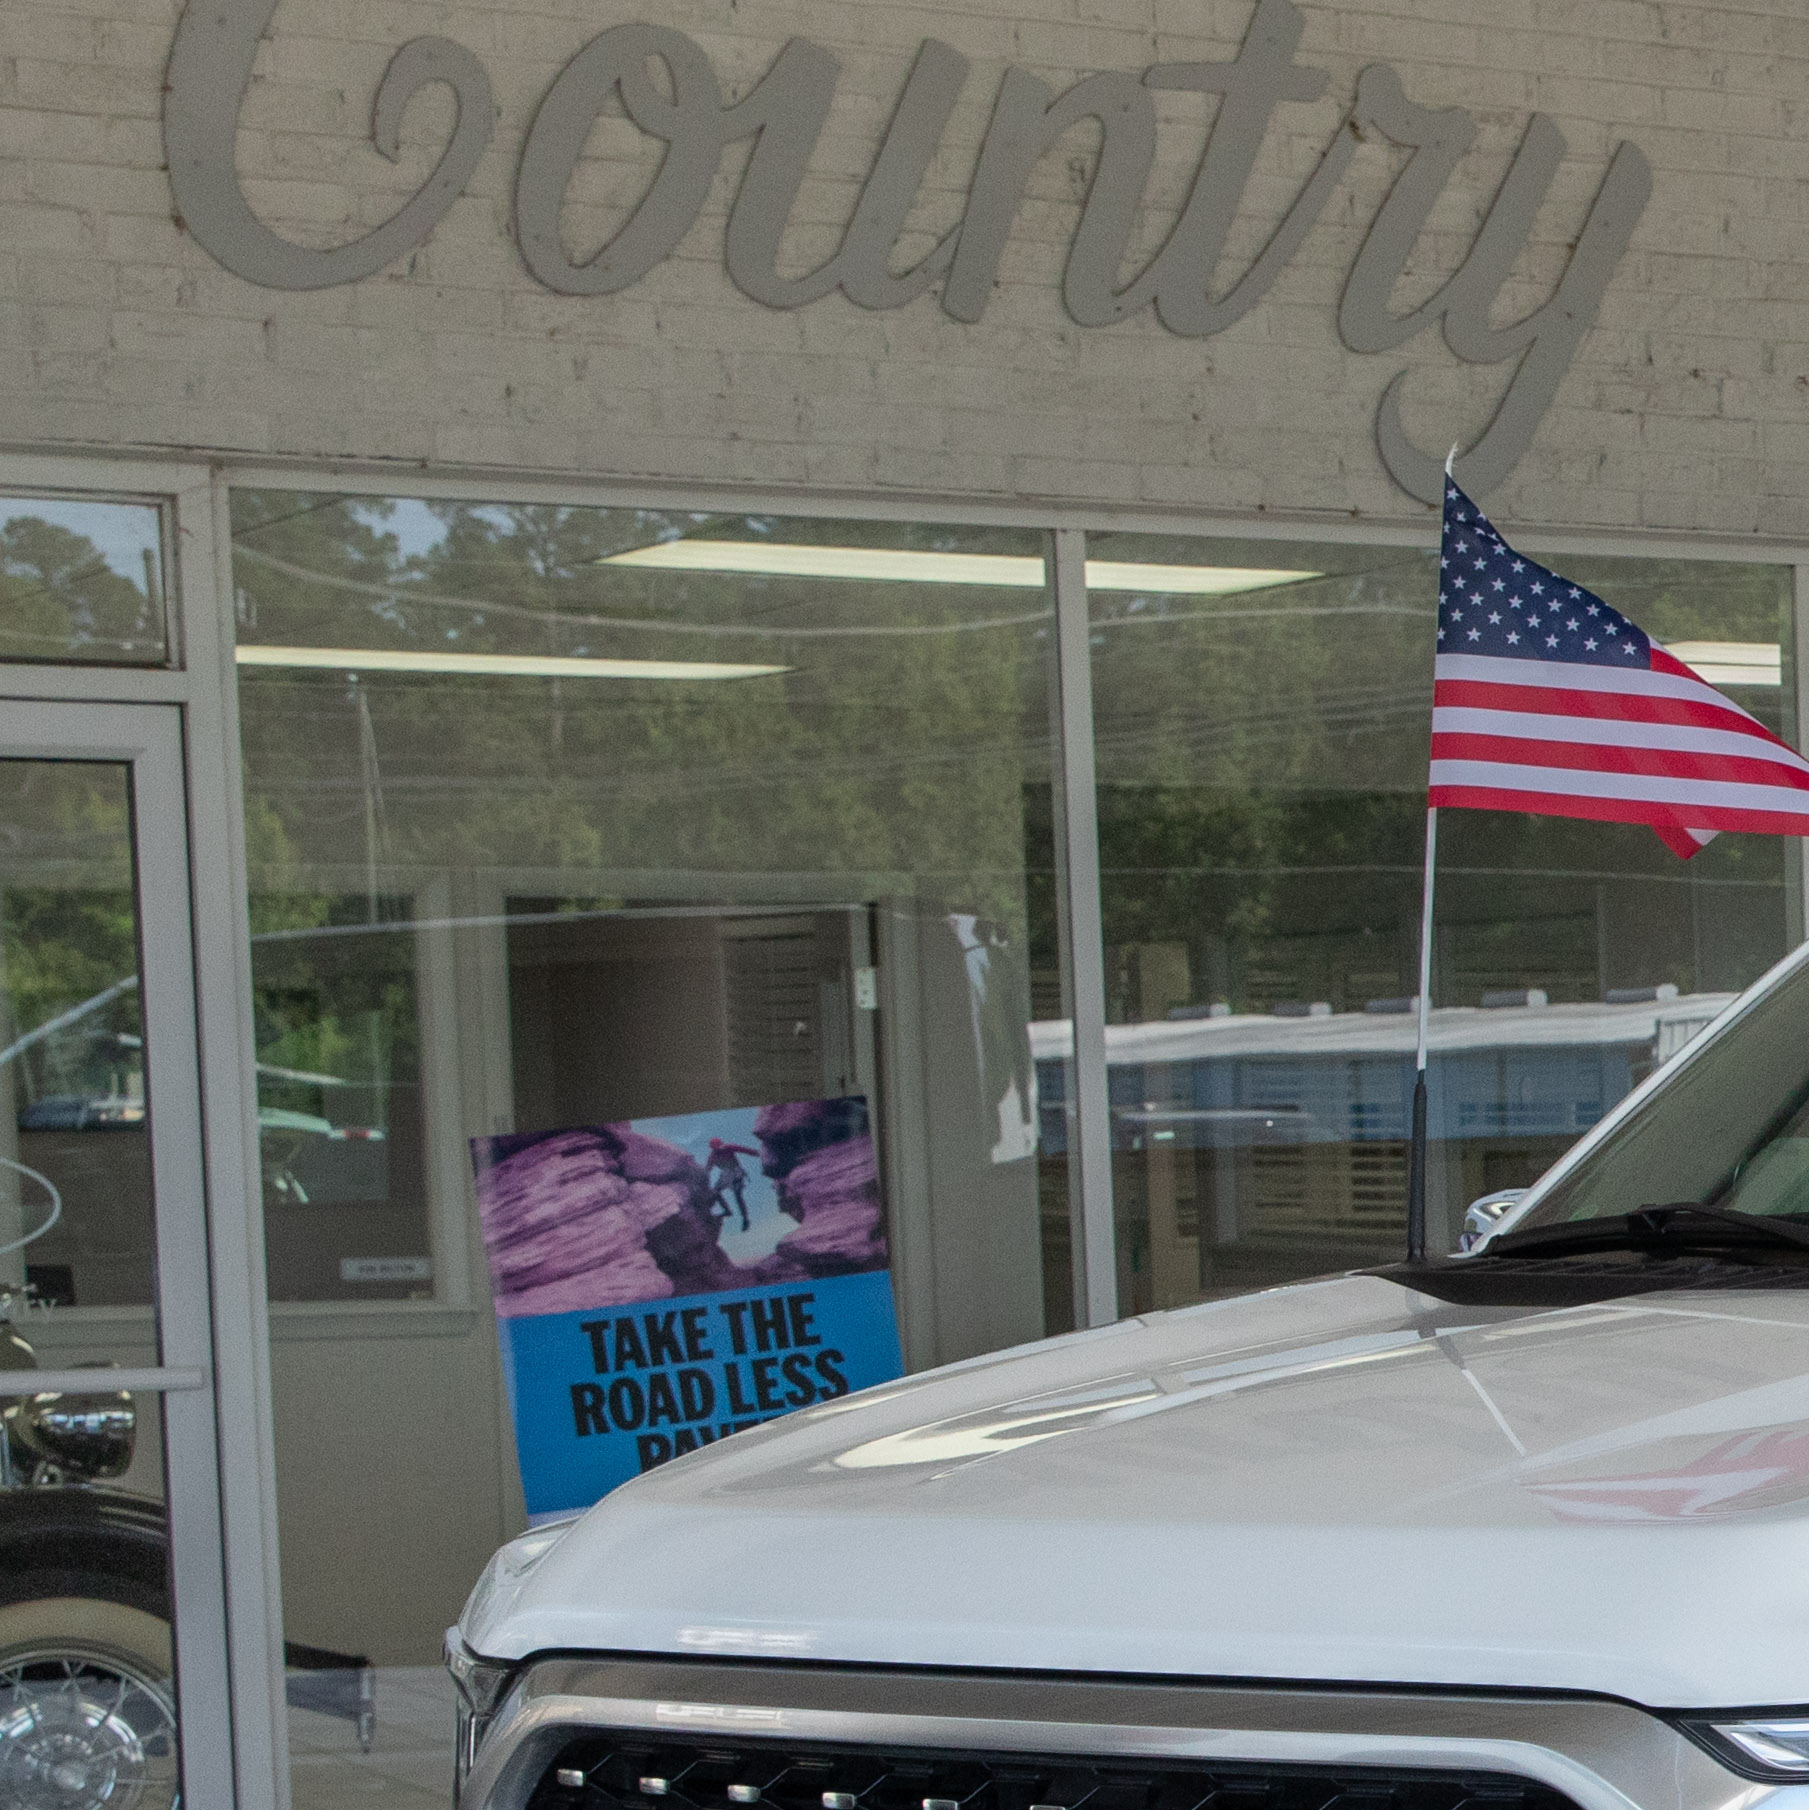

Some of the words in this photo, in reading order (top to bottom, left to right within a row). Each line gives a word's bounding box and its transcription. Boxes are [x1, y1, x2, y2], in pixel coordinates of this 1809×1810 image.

[580, 1307, 714, 1375] TAKE
[720, 1293, 822, 1356] THE
[569, 1366, 716, 1438] ROAD
[725, 1348, 849, 1418] LESS
